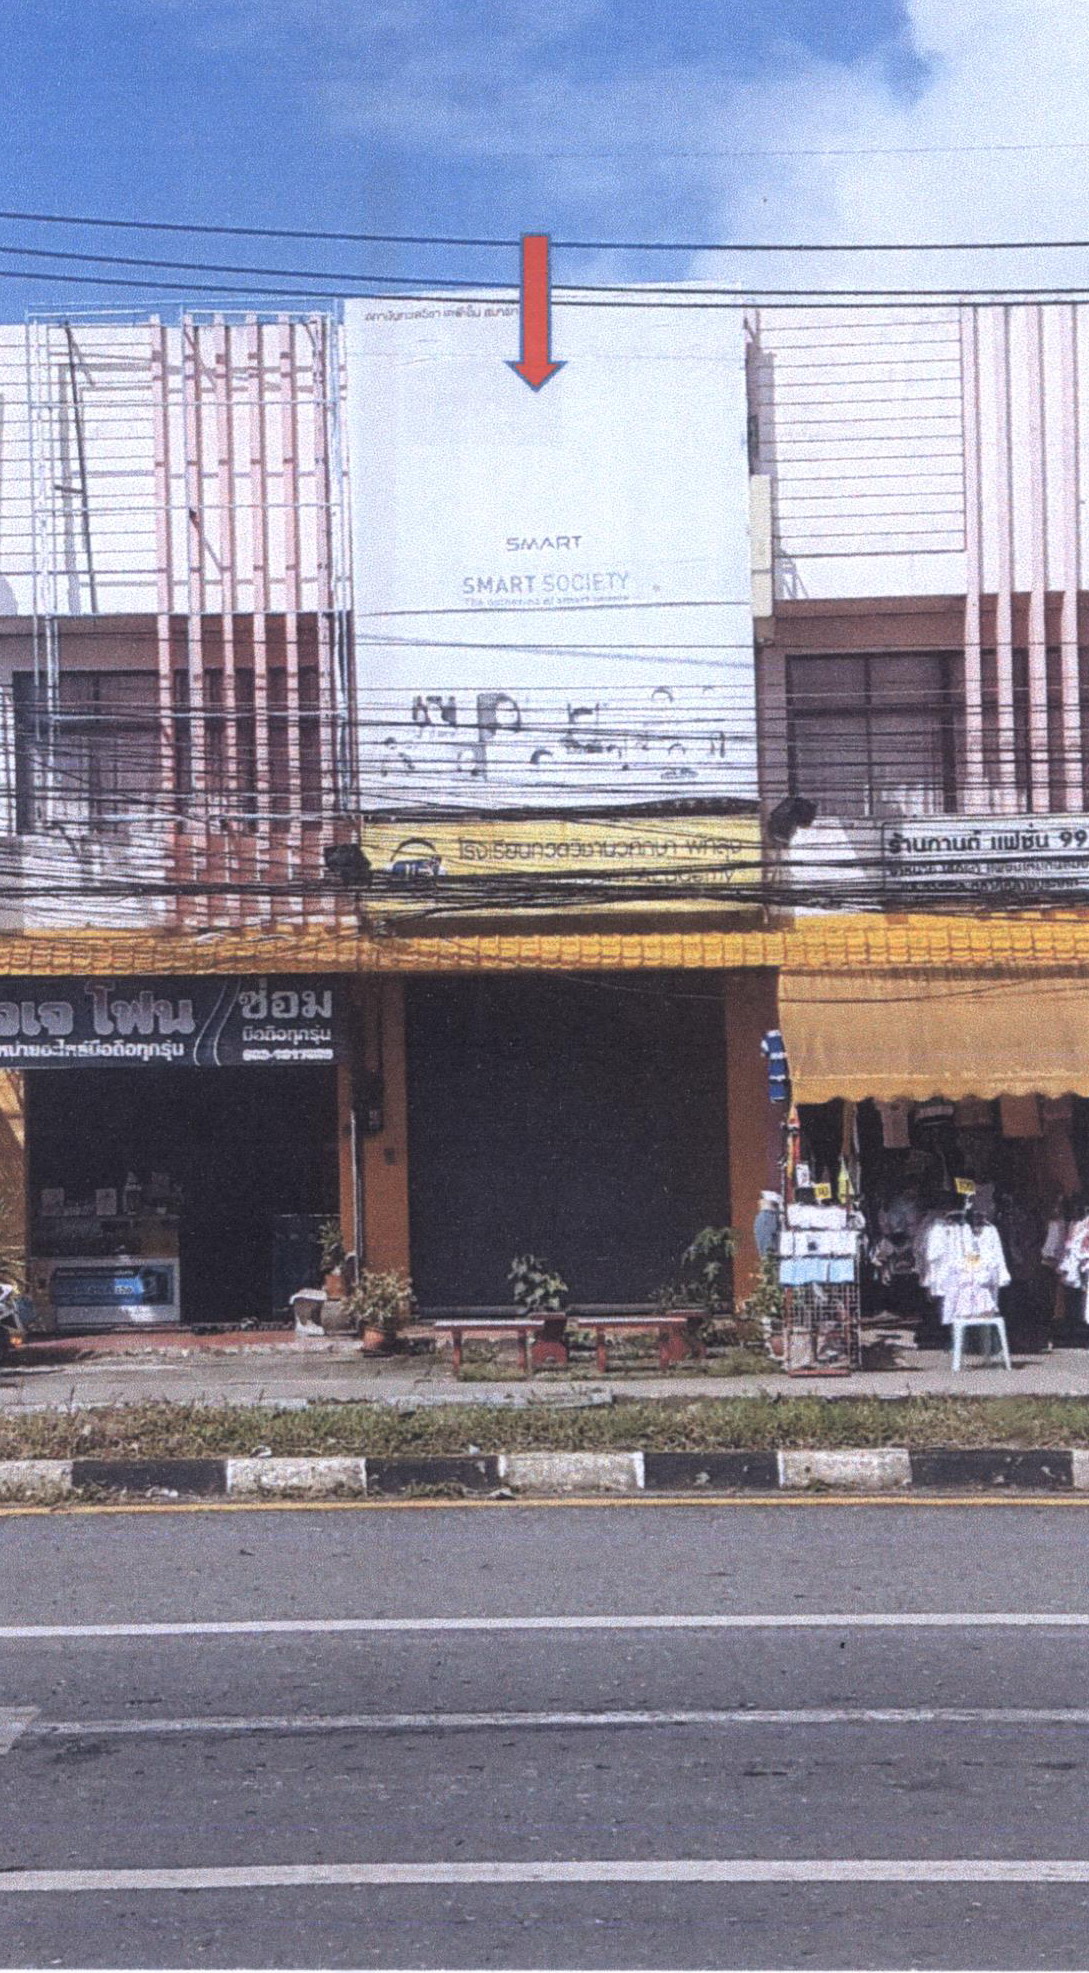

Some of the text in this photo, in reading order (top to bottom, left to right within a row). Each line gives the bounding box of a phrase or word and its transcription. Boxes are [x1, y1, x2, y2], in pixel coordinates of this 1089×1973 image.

[506, 535, 582, 551] SMART
[463, 571, 629, 594] SMART SOCIETY
[1060, 830, 1088, 848] 99
[84, 980, 196, 1036] โฟน
[240, 978, 333, 1019] ซ่อม
[242, 1025, 332, 1046] มือถือทุกรุ่น
